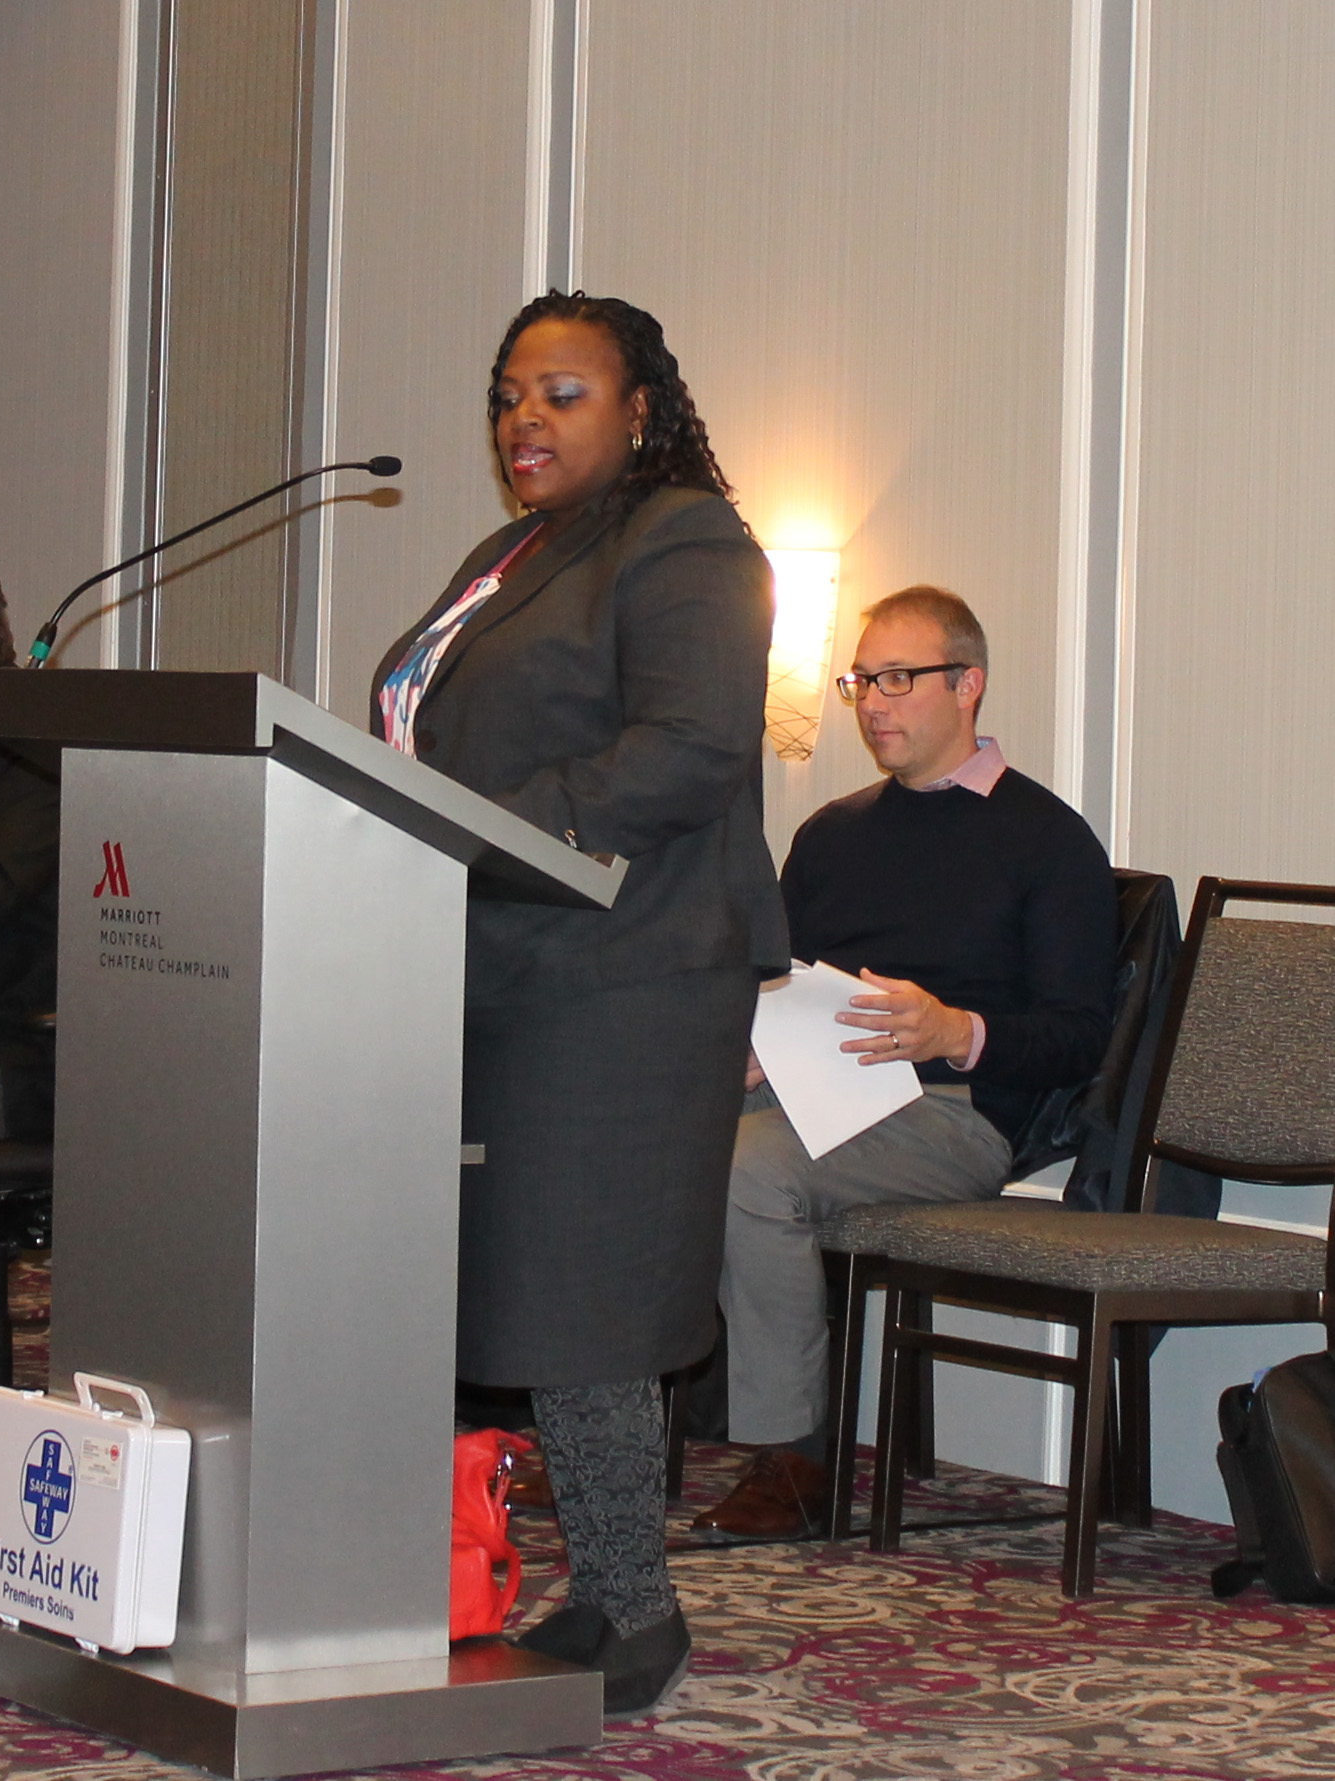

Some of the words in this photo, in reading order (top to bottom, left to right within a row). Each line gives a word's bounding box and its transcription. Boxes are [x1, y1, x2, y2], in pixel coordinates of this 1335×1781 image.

[100, 908, 161, 926] MARRIOTT
[100, 930, 163, 950] MONTREAL
[100, 953, 154, 972] CHATEAU
[158, 958, 230, 980] CHAMPLAIN
[29, 1478, 68, 1501] SAFEWAY
[29, 1550, 64, 1590] Aid
[70, 1561, 99, 1602] Kit
[2, 1581, 44, 1611] Premiers
[47, 1595, 74, 1621] Soins
